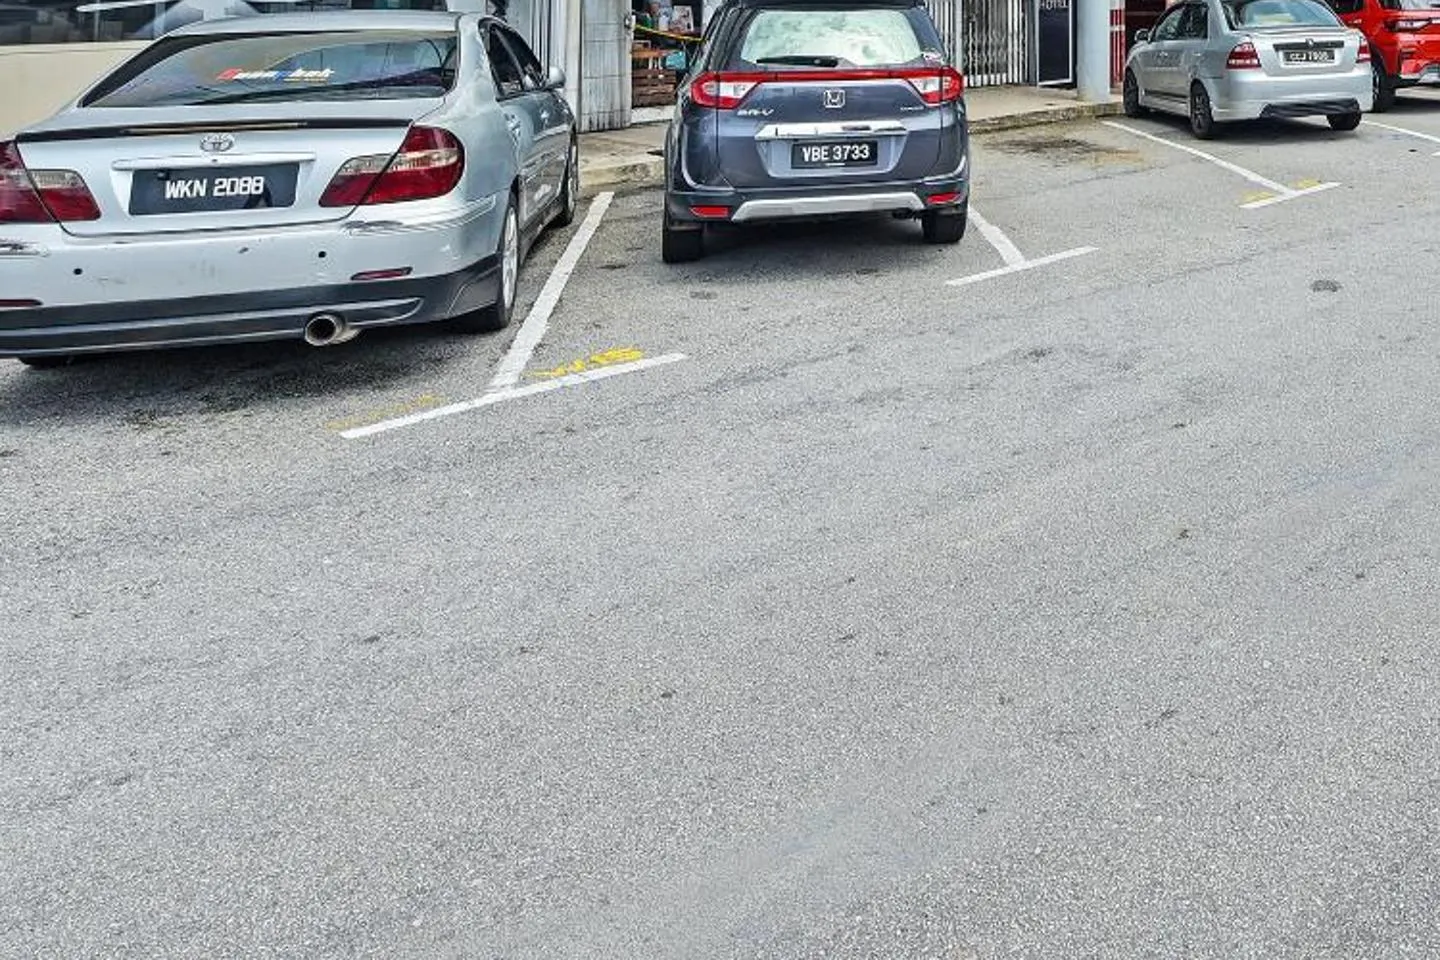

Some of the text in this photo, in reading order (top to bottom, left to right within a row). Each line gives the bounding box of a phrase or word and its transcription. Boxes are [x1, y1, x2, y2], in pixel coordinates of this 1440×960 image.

[802, 143, 871, 162] VBE 3733
[164, 175, 266, 199] WKN 2088
